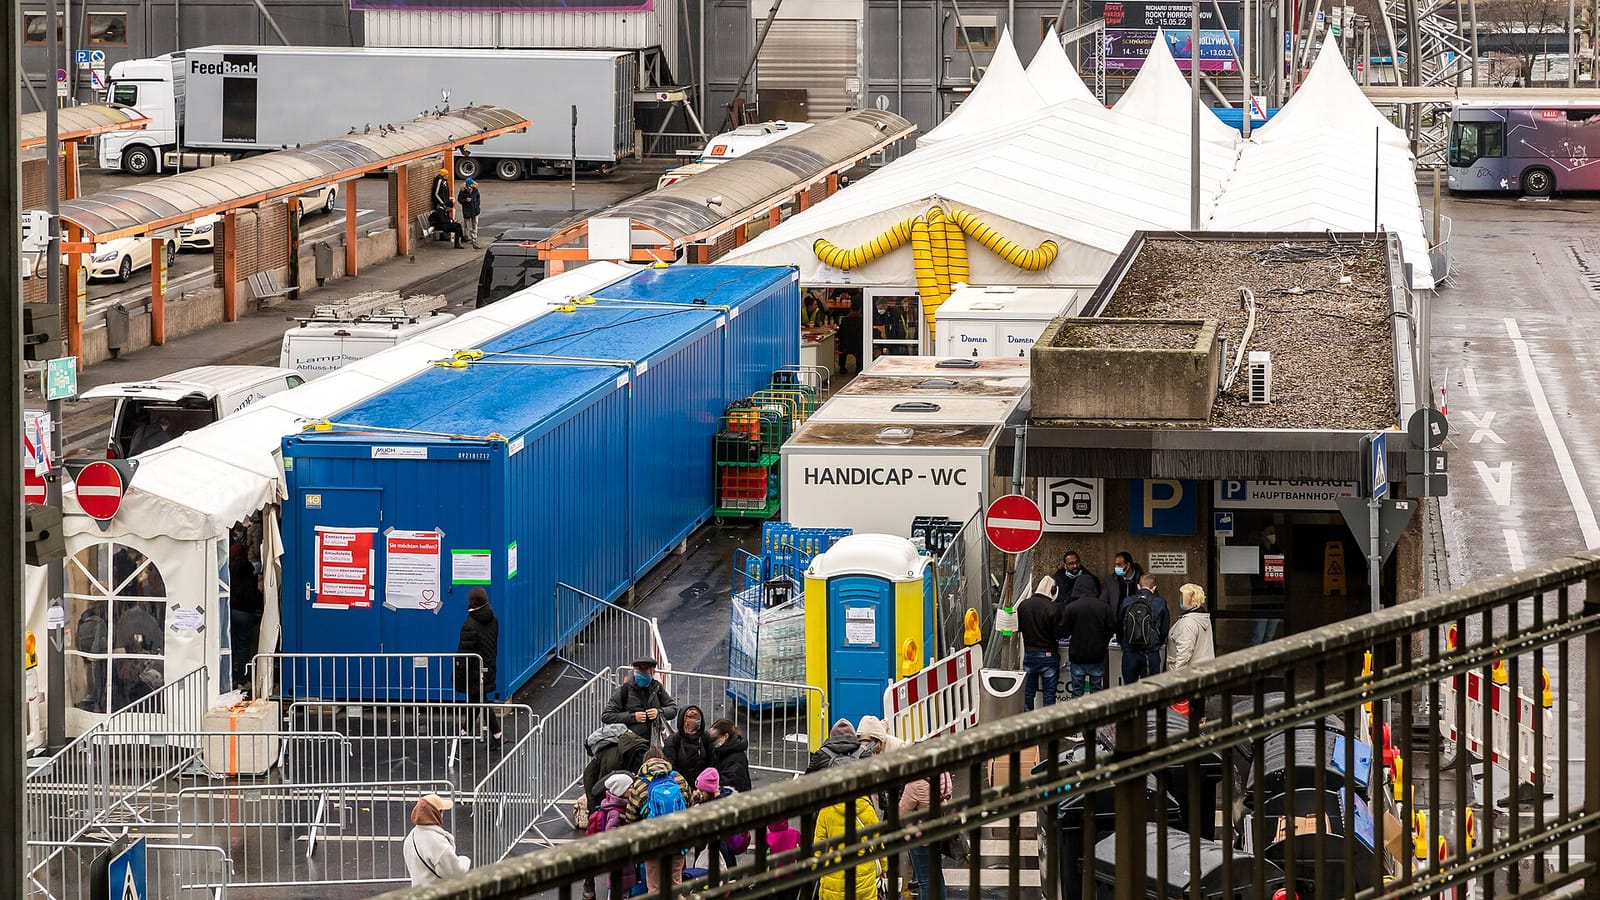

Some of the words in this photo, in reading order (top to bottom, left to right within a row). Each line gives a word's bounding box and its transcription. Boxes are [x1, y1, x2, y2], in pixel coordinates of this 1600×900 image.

[78, 52, 86, 62] P
[191, 61, 257, 74] FeedBack
[961, 335, 988, 343] Damen
[1007, 335, 1035, 344] Damen
[296, 355, 341, 364] Lamp
[804, 468, 913, 486] HANDICAP
[930, 468, 967, 486] WC
[1228, 480, 1241, 498] P
[1051, 492, 1070, 517] P
[1143, 479, 1184, 528] P
